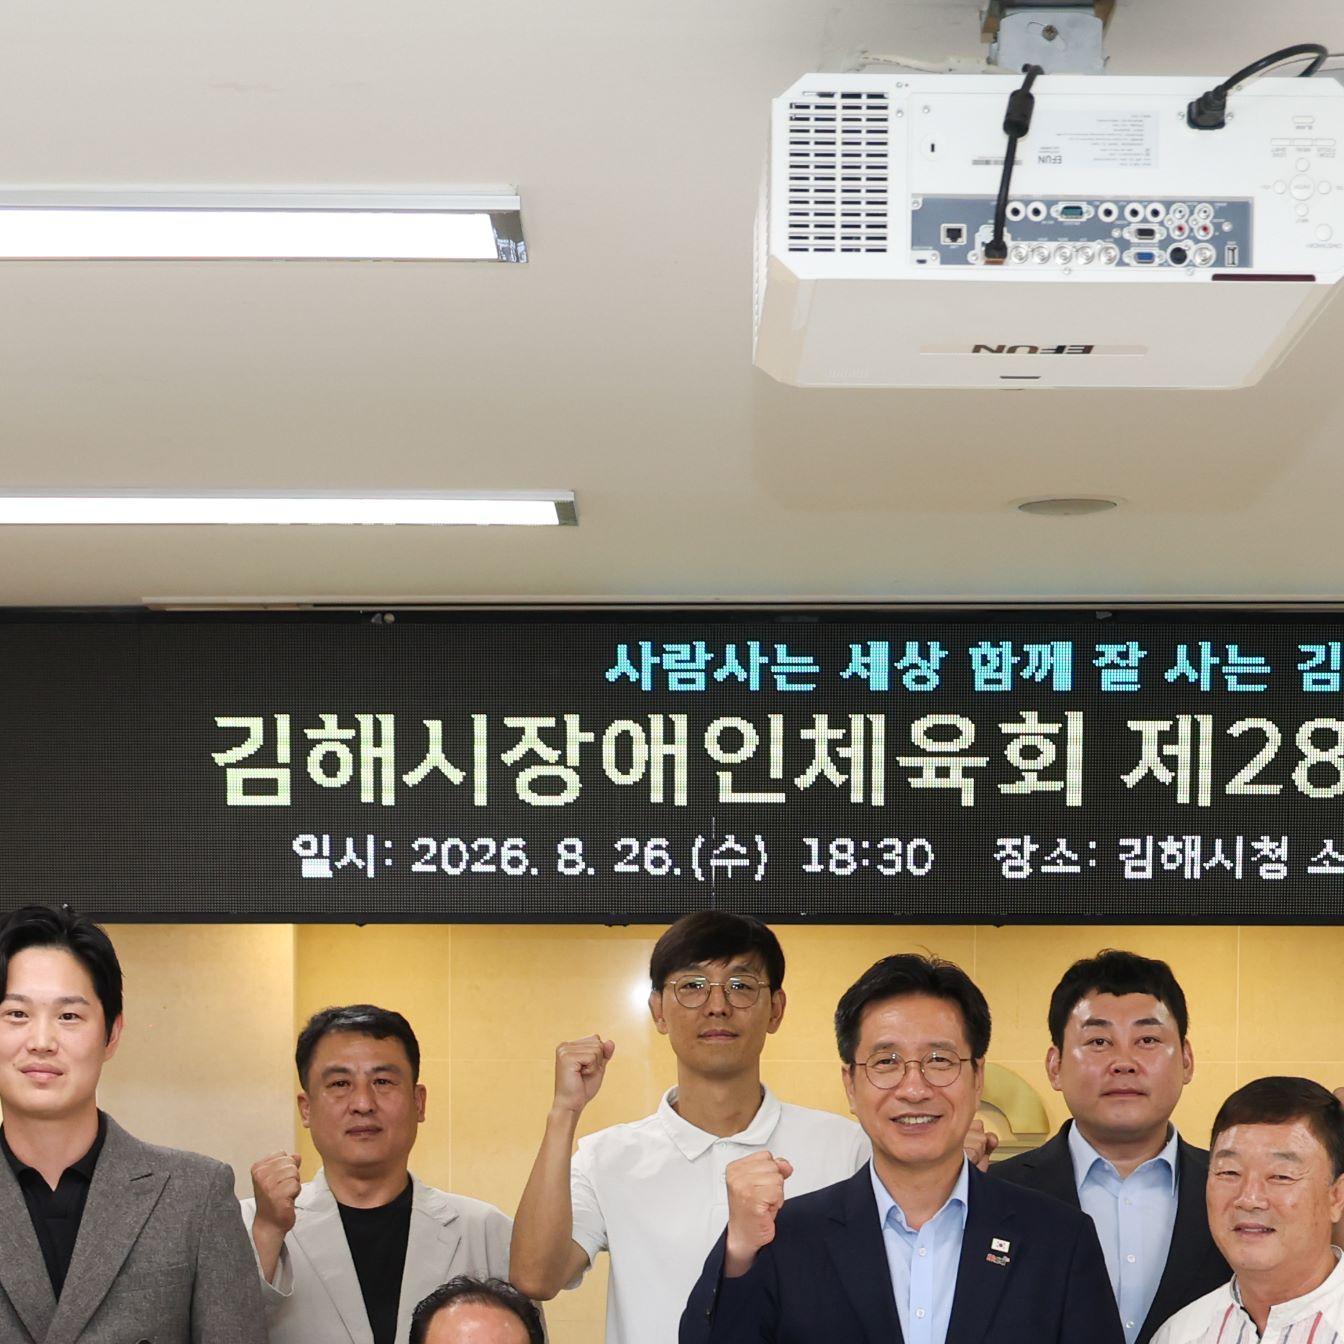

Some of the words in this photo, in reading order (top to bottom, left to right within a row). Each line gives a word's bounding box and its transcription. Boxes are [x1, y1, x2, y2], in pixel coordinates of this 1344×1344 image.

[1037, 155, 1062, 165] EFUN
[972, 344, 1095, 355] EFUN
[605, 641, 820, 692] 사람사는
[839, 641, 949, 692] 세상
[968, 641, 1072, 692] 함께
[1092, 641, 1148, 692] 잘
[1164, 641, 1271, 692] 사는
[211, 711, 1084, 807] 김해시장애인체육회
[292, 834, 393, 879] 일시:
[411, 837, 539, 876] 2026.
[557, 837, 595, 876] 8.
[613, 834, 768, 882] 26.(수)
[802, 837, 935, 876] 18:30
[993, 835, 1096, 879] 장소:
[1118, 835, 1288, 880] 김해시청
